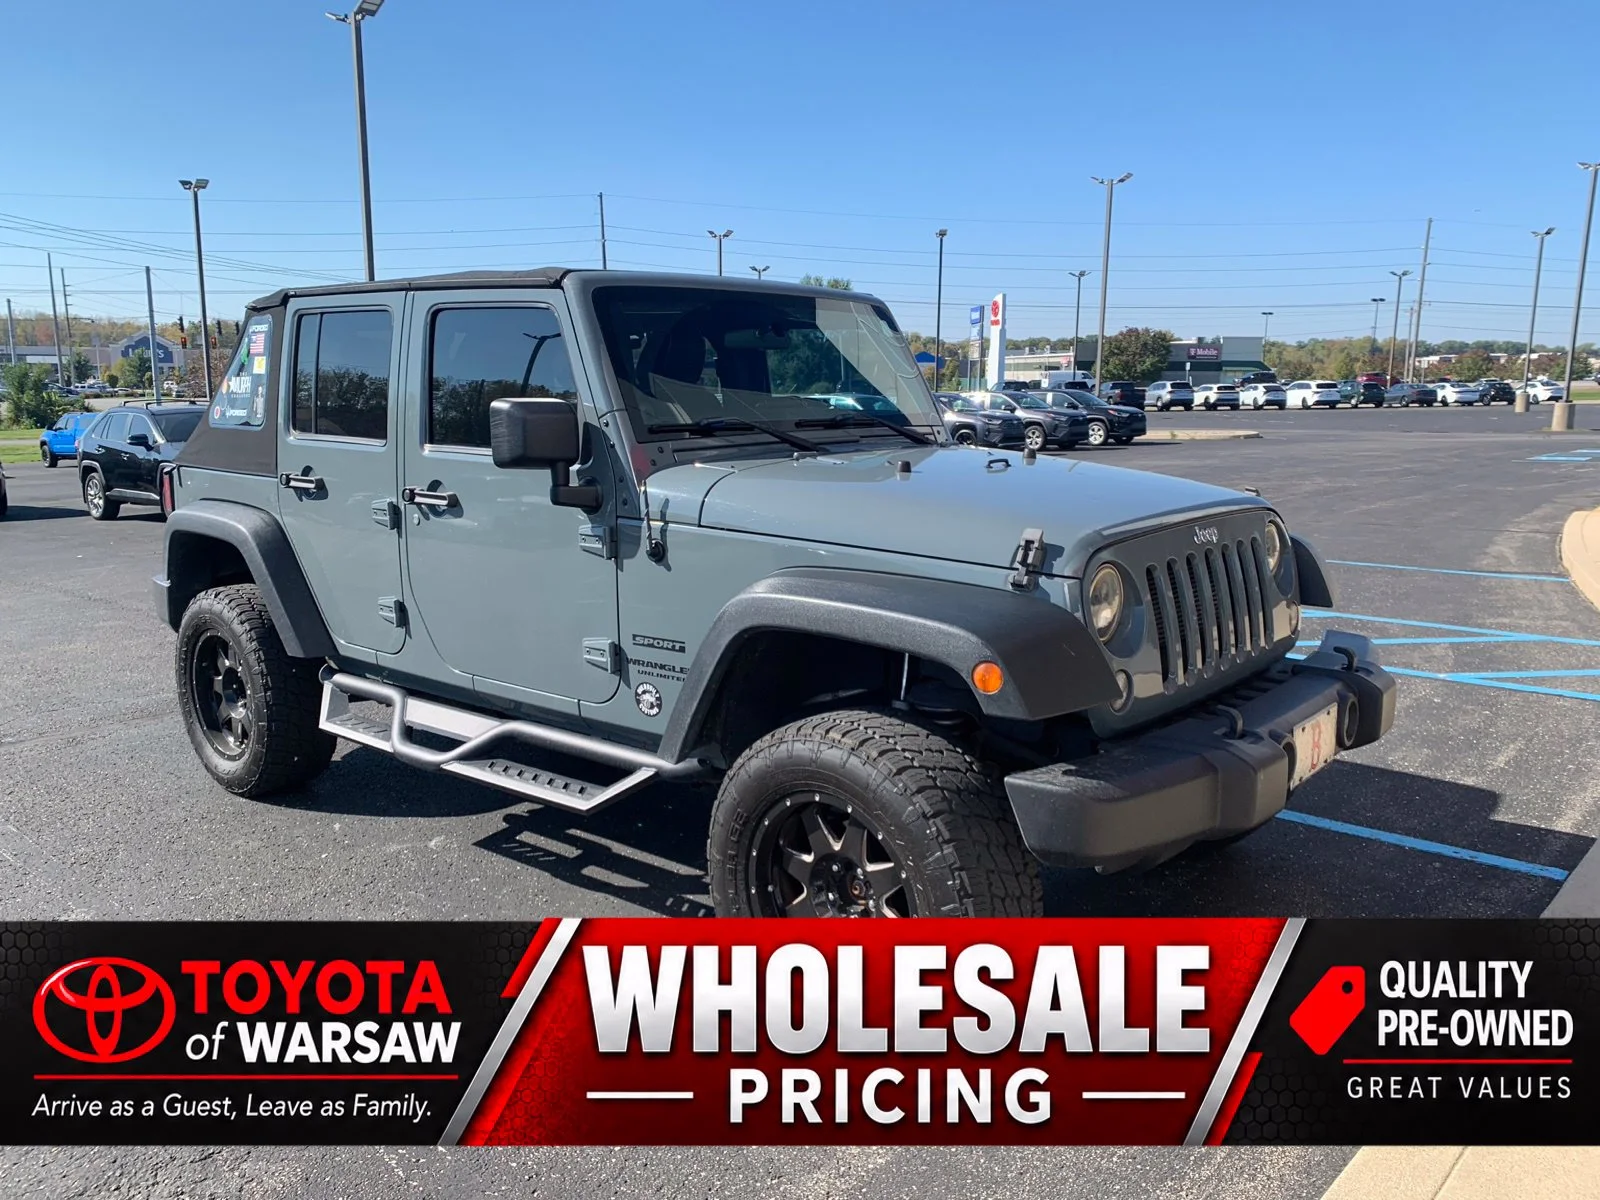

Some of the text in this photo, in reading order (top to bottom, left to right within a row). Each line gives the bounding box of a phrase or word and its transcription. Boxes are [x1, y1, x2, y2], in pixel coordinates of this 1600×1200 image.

[1193, 526, 1219, 544] Jeep
[634, 635, 686, 651] SPORT
[627, 657, 690, 674] WRANGLE
[637, 669, 686, 682] UNLIMITE
